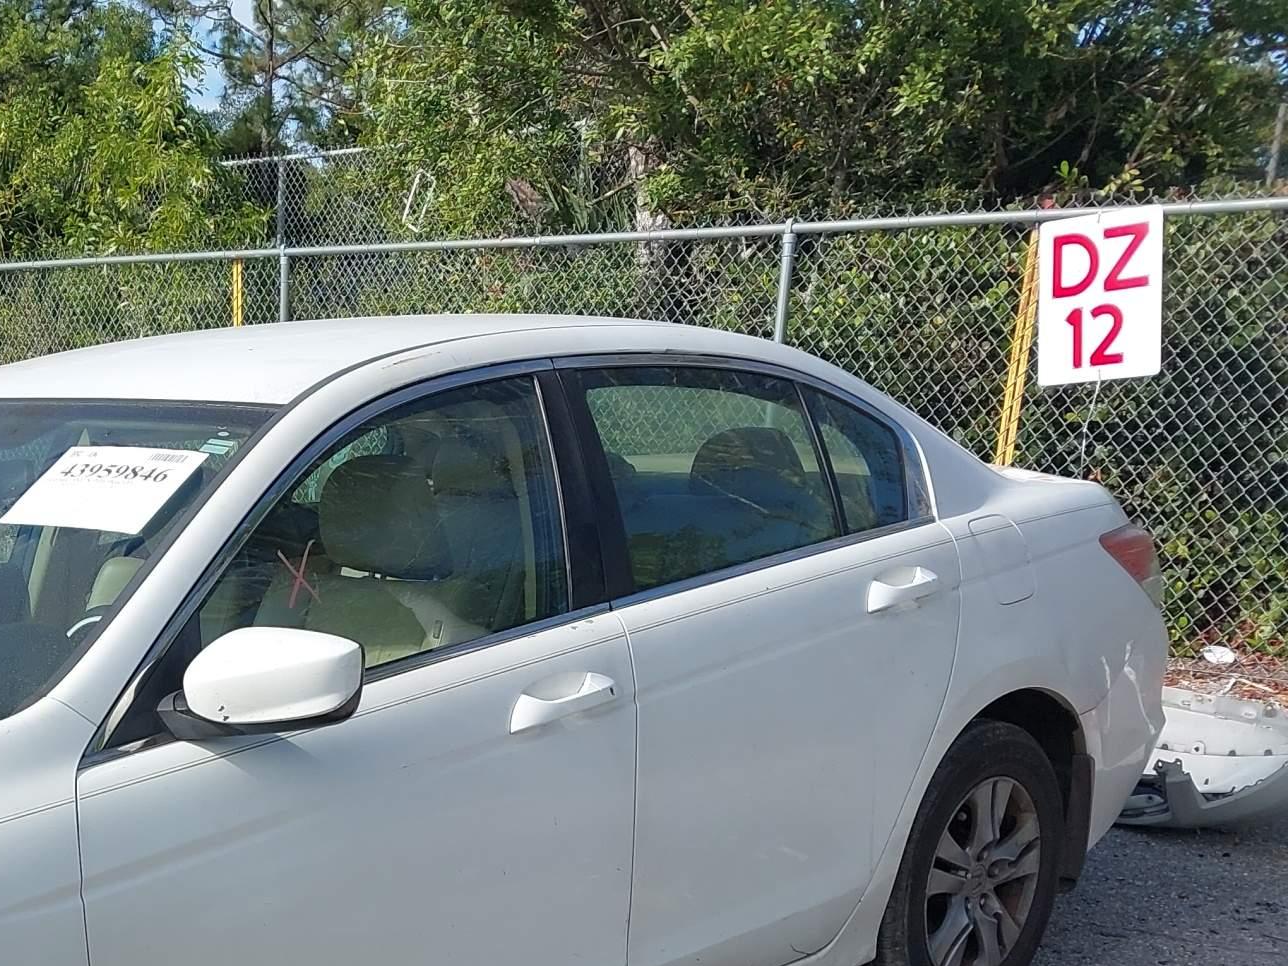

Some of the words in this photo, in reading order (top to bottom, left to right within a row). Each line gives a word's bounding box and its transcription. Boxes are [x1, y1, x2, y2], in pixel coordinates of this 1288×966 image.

[1052, 221, 1150, 299] DZ
[1065, 303, 1124, 369] 12
[60, 463, 177, 483] 43959846
